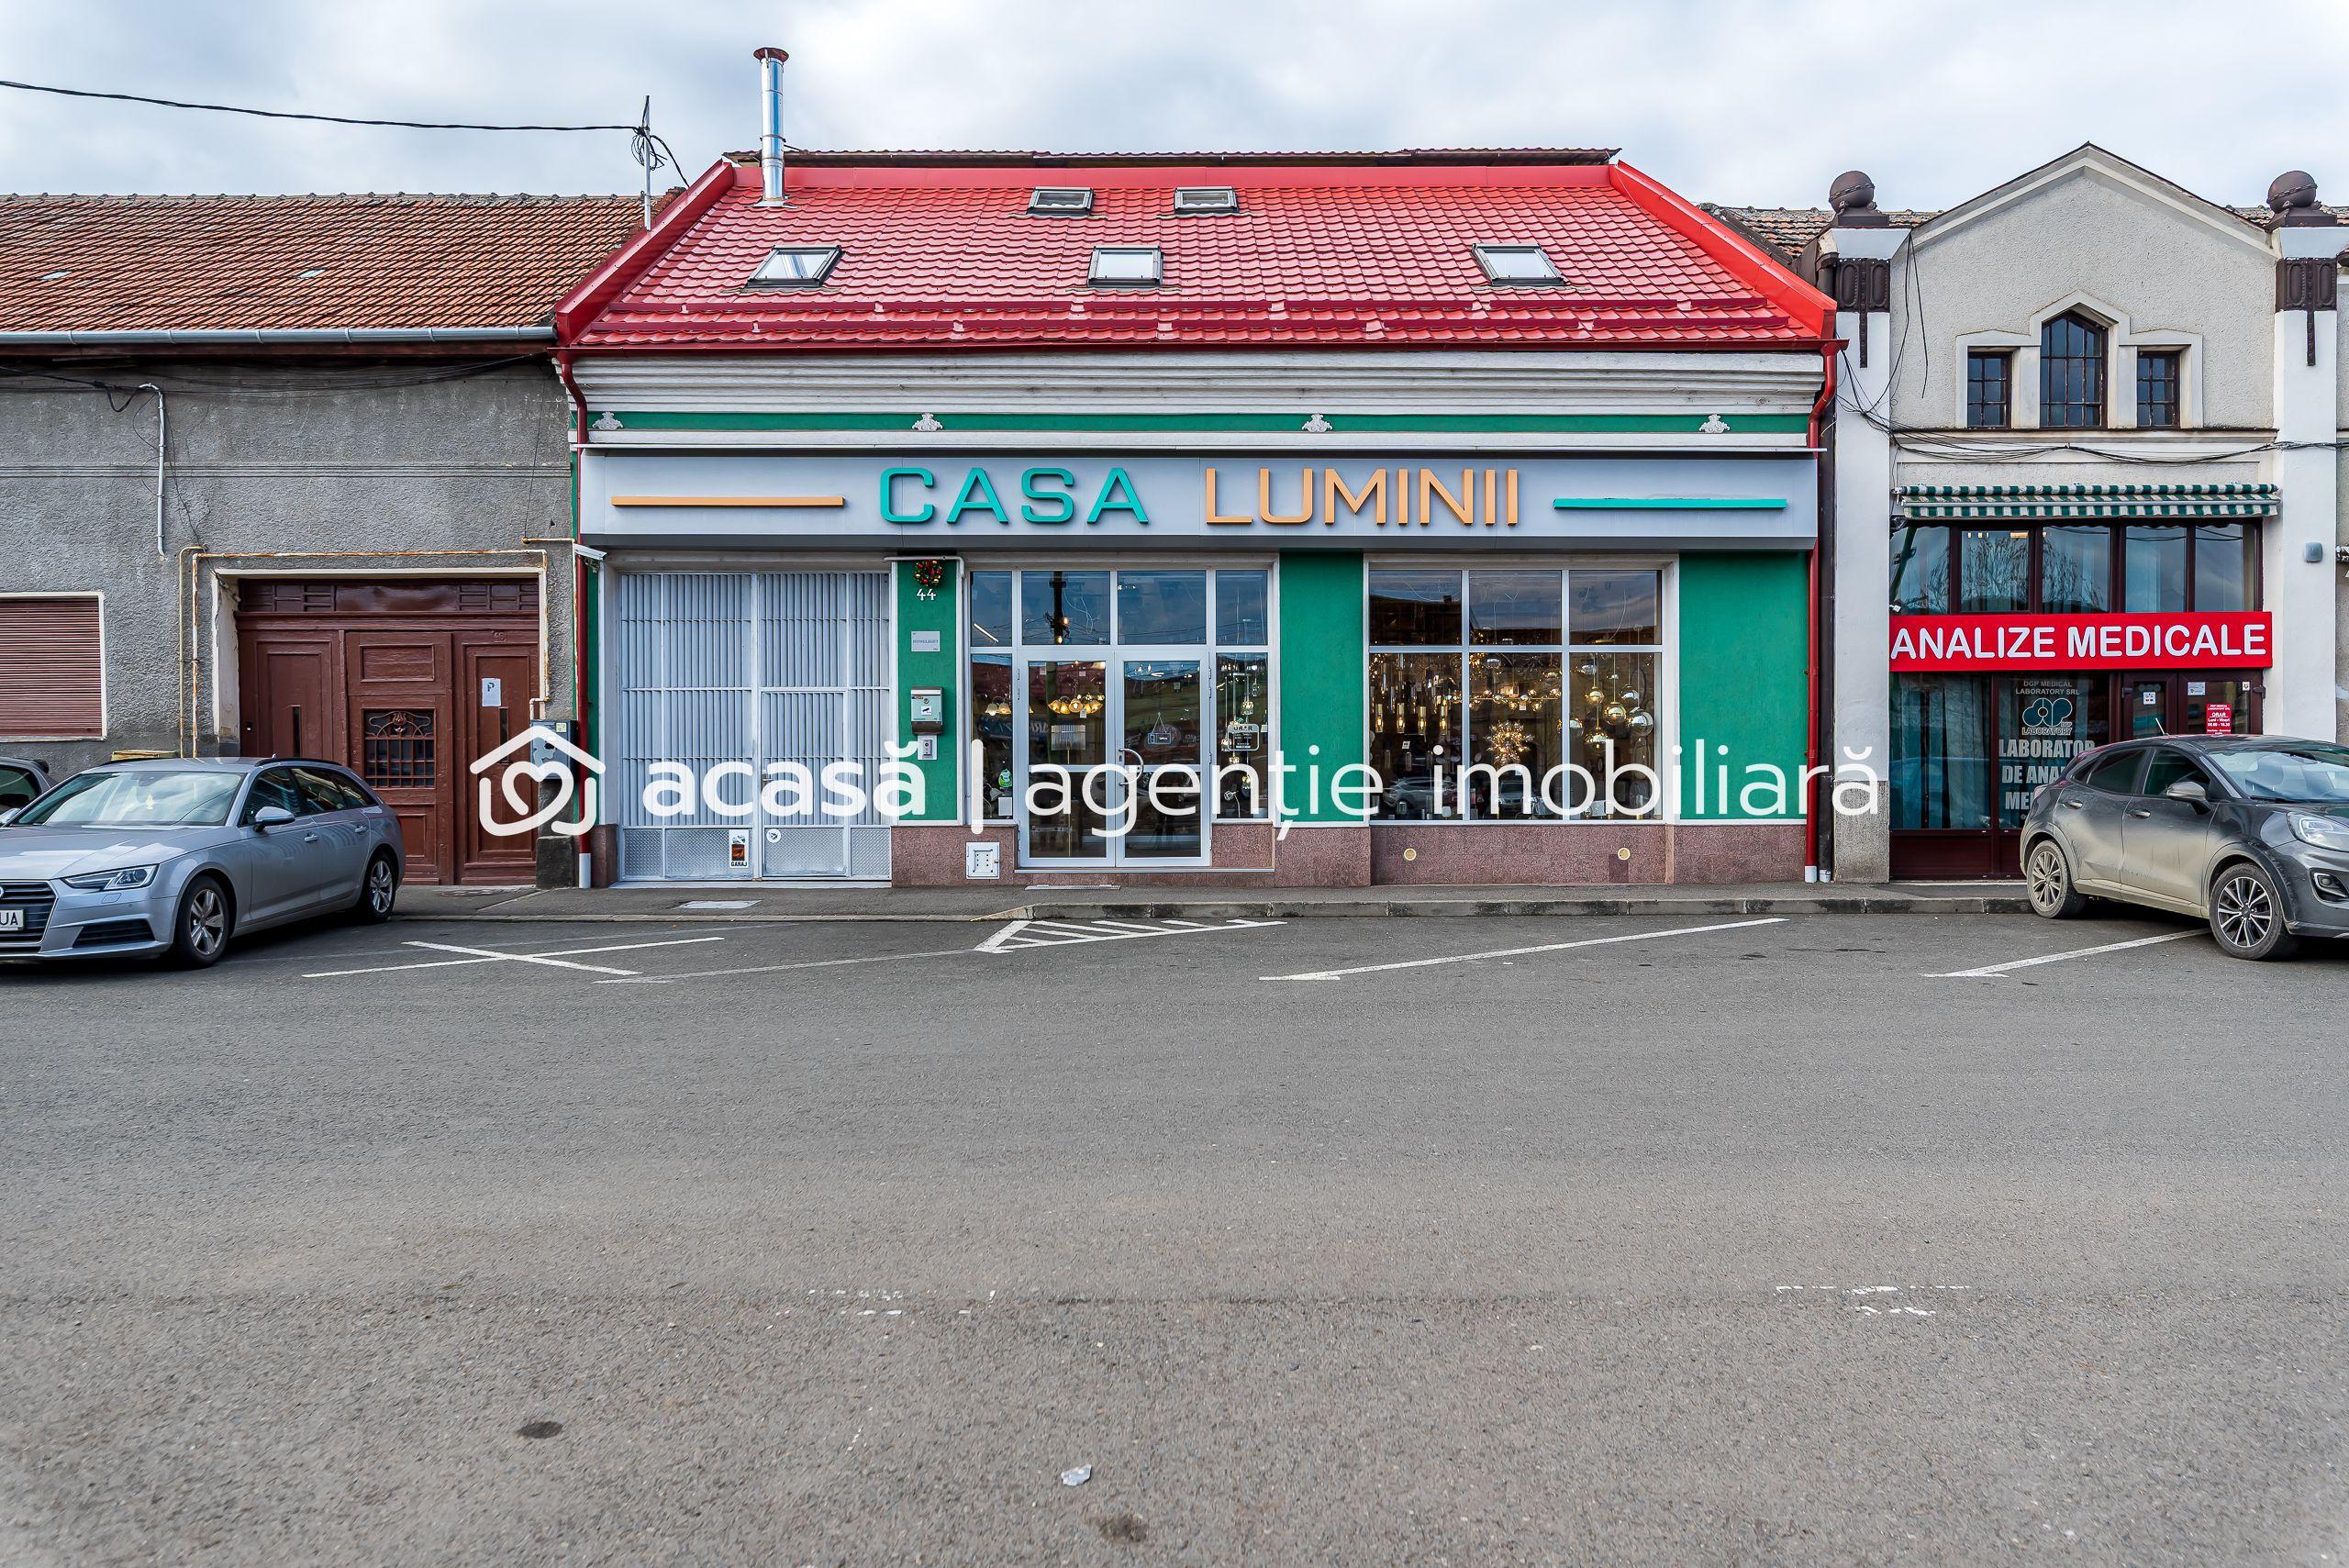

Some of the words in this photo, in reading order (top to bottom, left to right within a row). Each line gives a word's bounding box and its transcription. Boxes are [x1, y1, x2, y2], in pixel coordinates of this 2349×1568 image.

[879, 467, 1149, 524] CASA
[1206, 468, 1519, 526] LUMINII
[917, 588, 937, 601] 44
[1890, 627, 2056, 659] ANALIZE
[2067, 624, 2266, 658] MEDICALE
[487, 682, 495, 692] P
[2021, 727, 2073, 736] LABORATORY
[2001, 765, 2023, 784] DE
[2026, 765, 2065, 784] ANA
